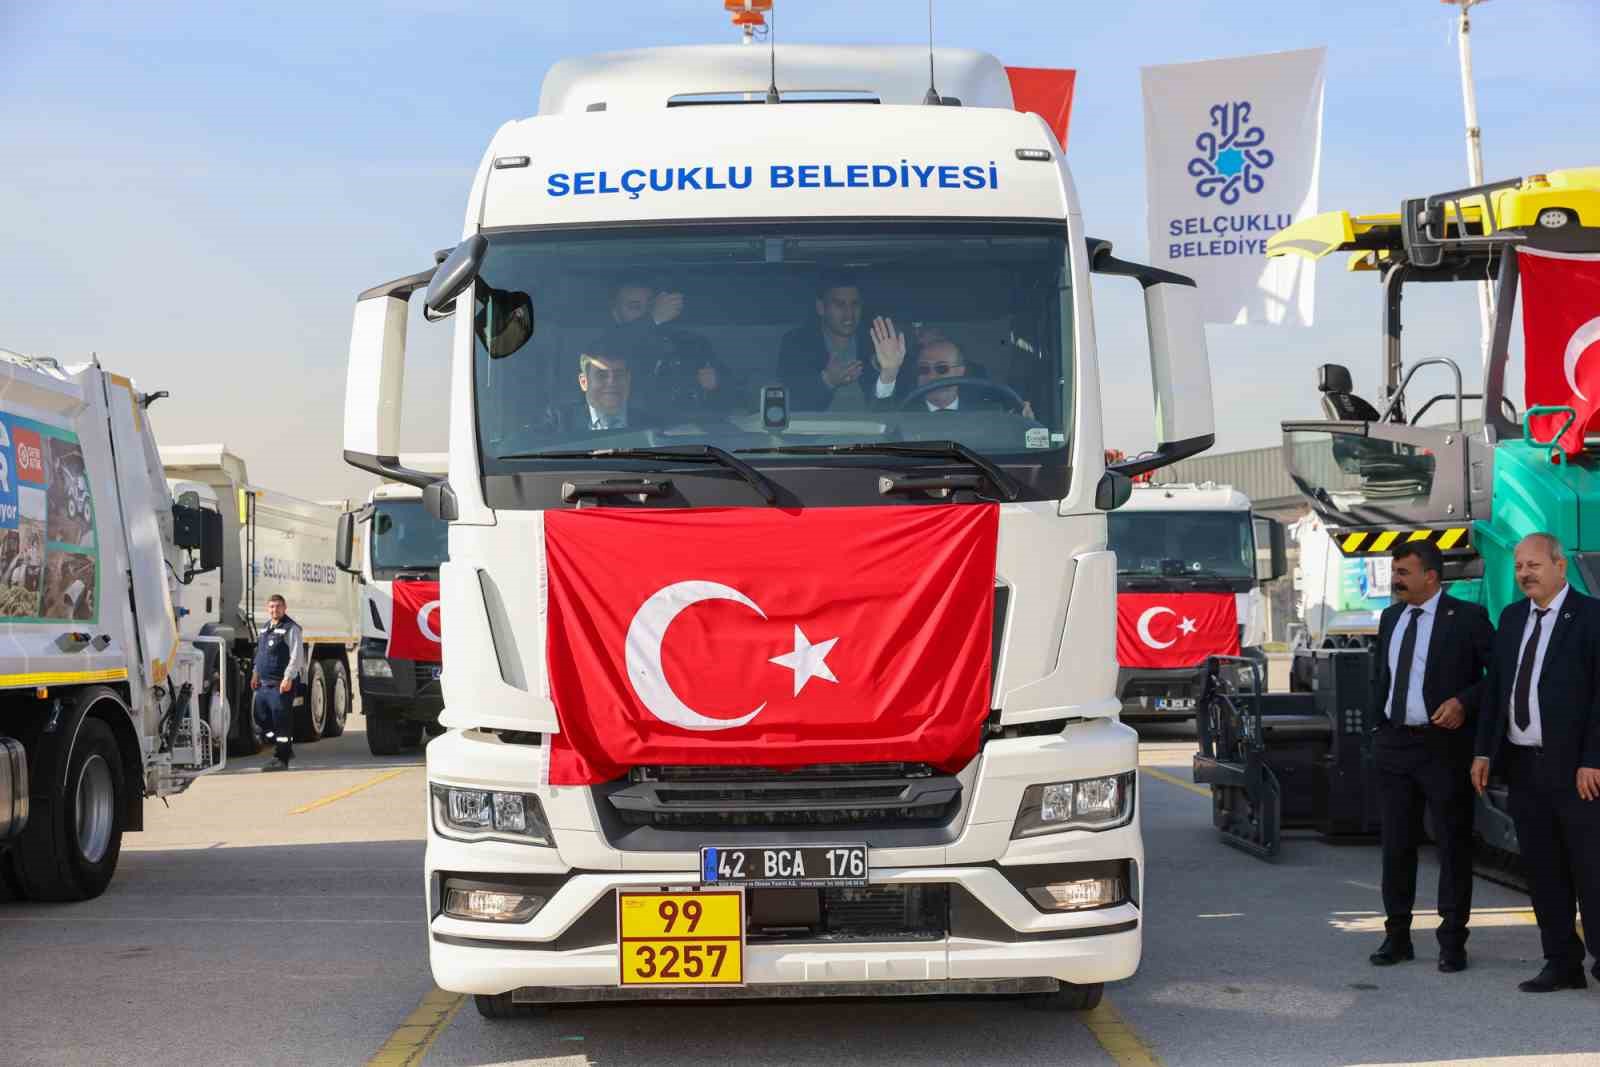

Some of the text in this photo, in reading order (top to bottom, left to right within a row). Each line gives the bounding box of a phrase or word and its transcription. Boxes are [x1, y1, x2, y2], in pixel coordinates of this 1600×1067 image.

[546, 159, 999, 200] SELÇUKLU BELEDİYESİ
[1169, 213, 1292, 238] SELÇUKLU
[718, 849, 864, 878] 42 BCA 176
[658, 899, 703, 933] 99
[635, 944, 728, 978] 3257
